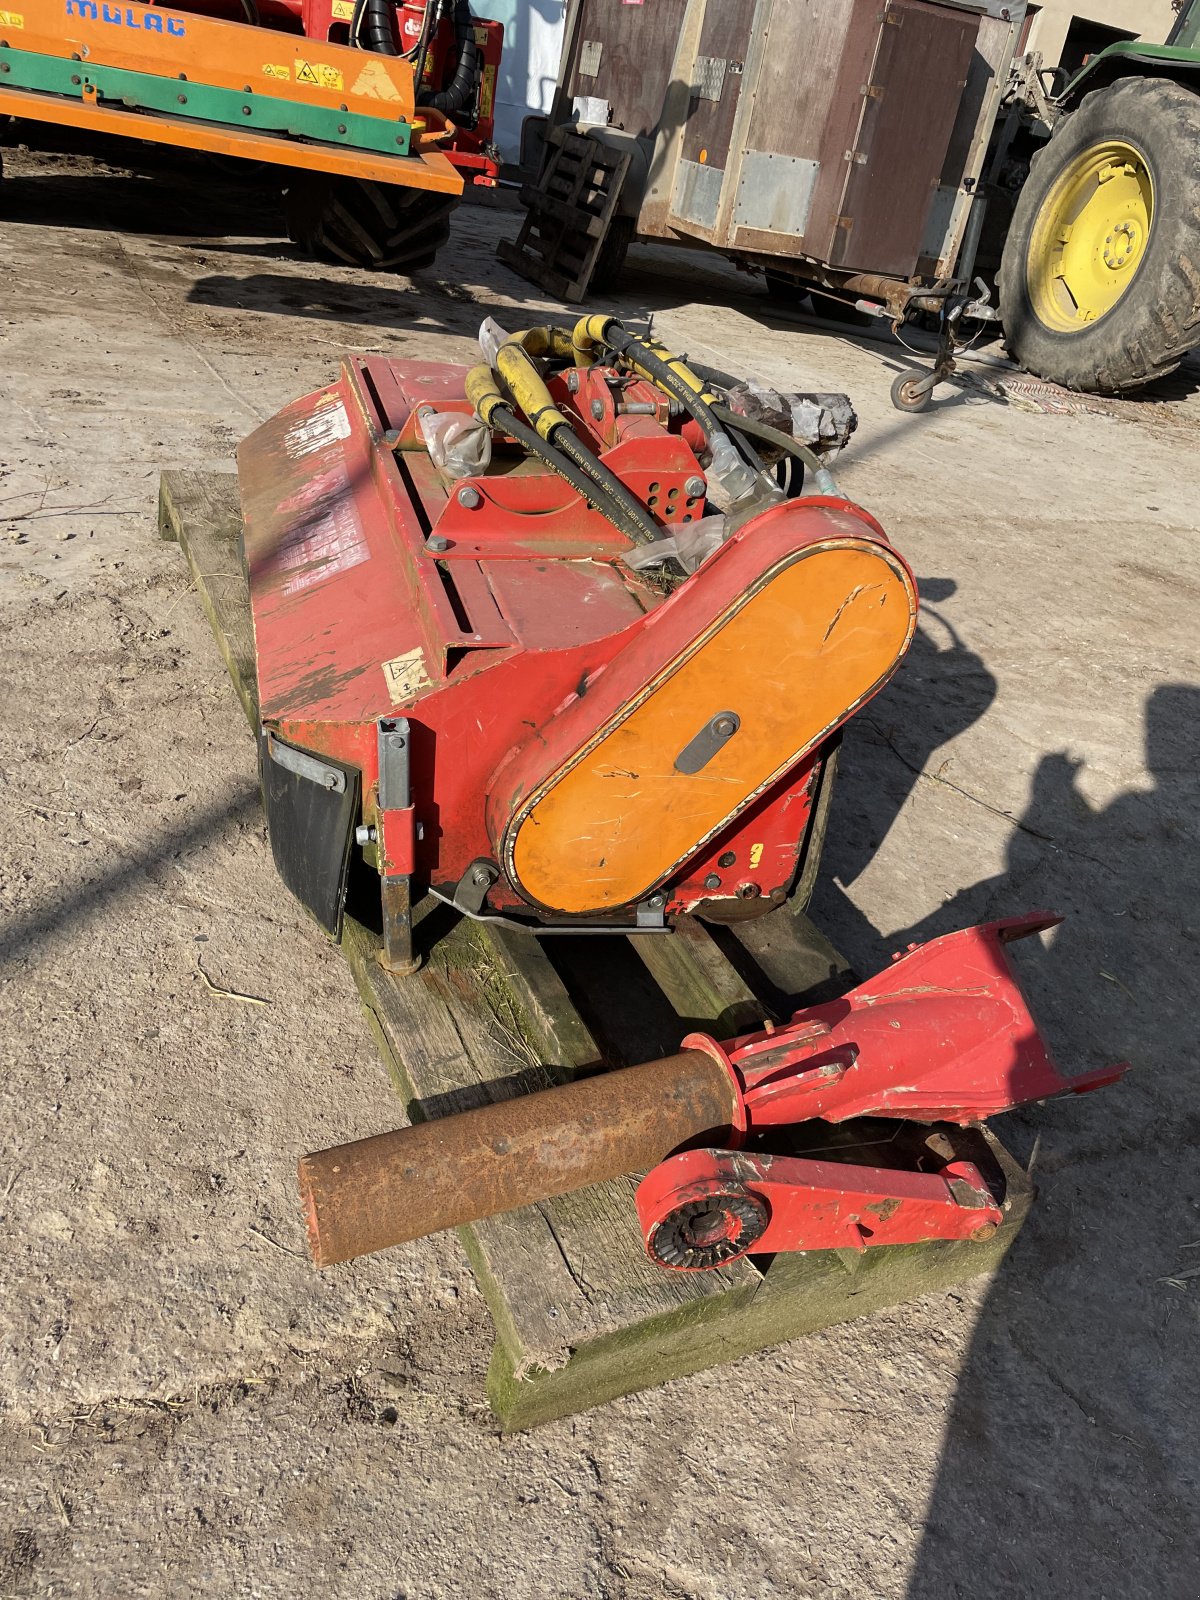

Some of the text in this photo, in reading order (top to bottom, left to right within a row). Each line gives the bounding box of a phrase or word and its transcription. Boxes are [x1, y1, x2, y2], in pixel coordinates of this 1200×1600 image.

[65, 0, 186, 37] MULAG
[553, 431, 577, 455] EXCEEDS
[572, 451, 586, 464] DIN
[581, 460, 593, 472] EN
[642, 528, 655, 541] ISO
